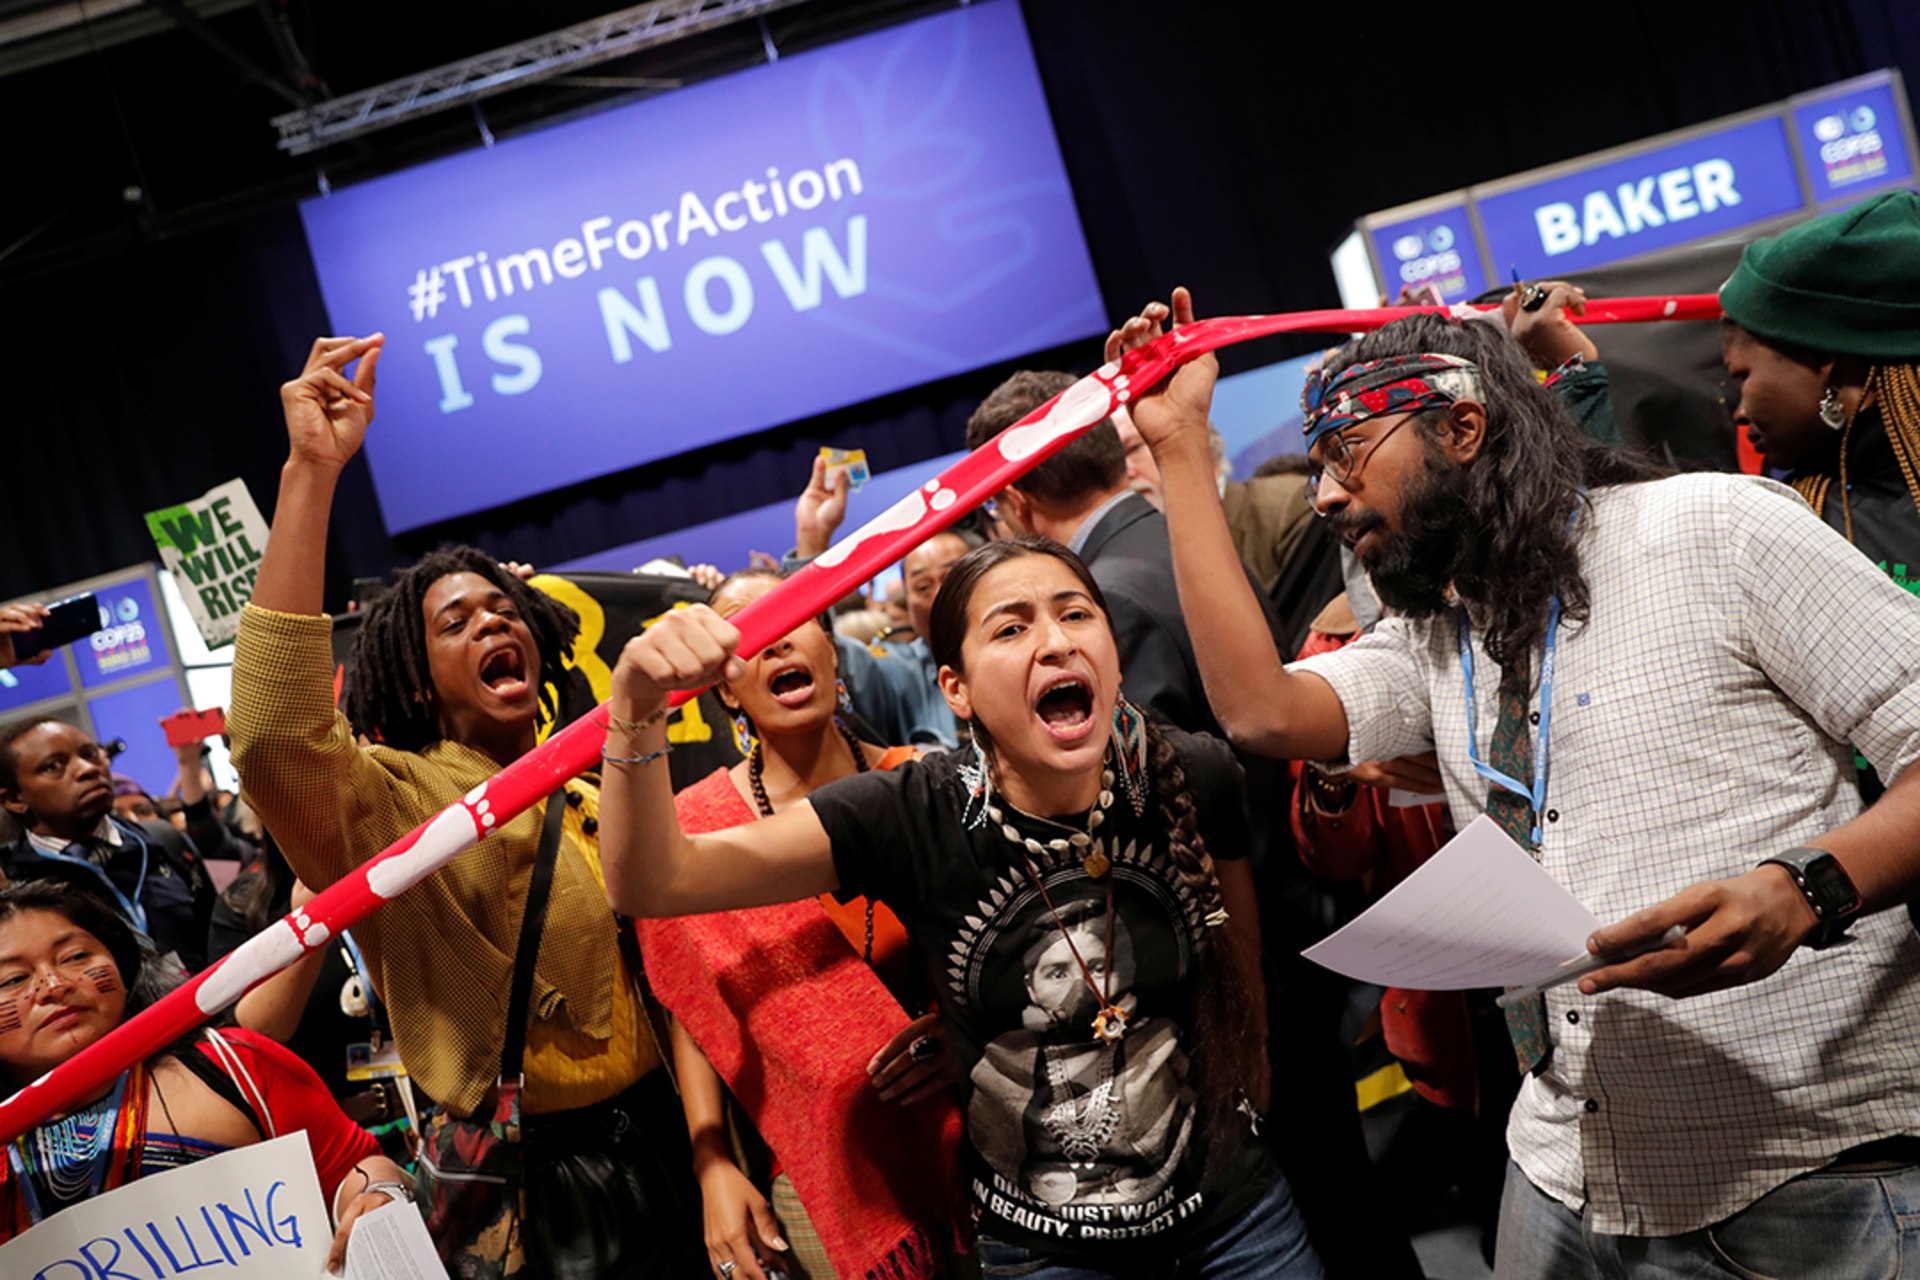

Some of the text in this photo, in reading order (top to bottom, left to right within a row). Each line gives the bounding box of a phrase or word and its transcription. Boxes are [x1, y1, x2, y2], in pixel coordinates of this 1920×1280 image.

[1534, 158, 1743, 256] BAKER
[407, 158, 864, 322] #TimeForAction
[423, 215, 868, 434] IS NOW
[159, 496, 245, 558] WE
[178, 534, 262, 586] WILL
[972, 1178, 989, 1204] IN
[990, 1193, 1073, 1238] BEAUTY.
[1080, 1209, 1174, 1240] PROTECT
[1055, 1205, 1114, 1222] JUST
[1119, 1185, 1175, 1221] WALK
